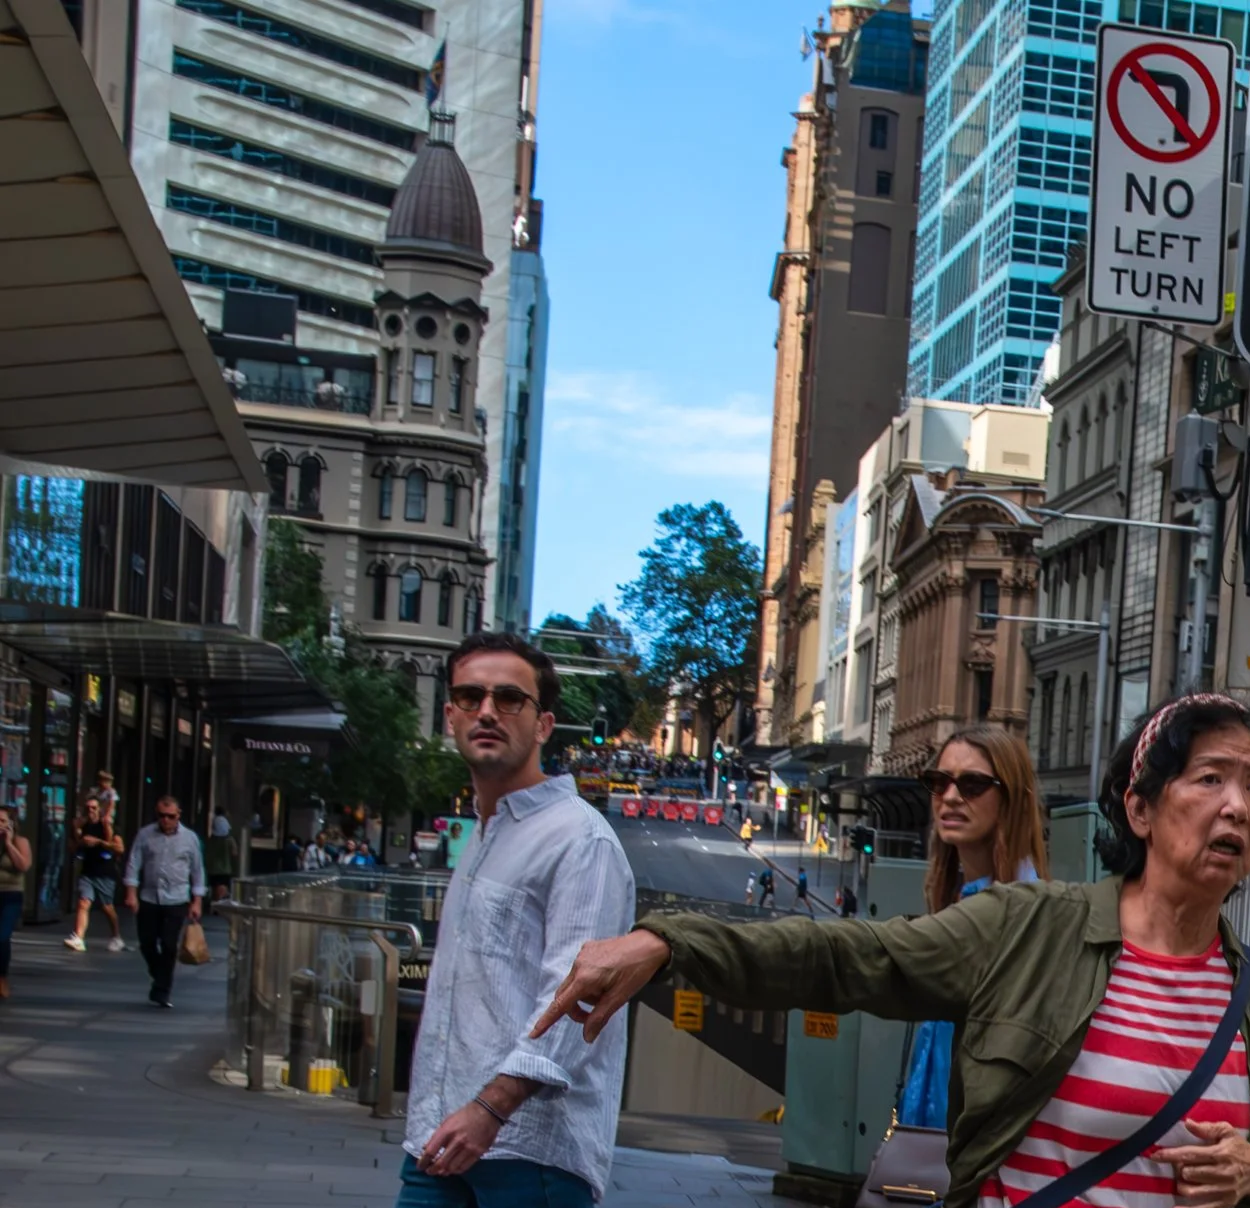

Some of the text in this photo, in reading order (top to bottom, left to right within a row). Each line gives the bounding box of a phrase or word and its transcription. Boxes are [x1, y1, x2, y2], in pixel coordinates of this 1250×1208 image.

[1125, 172, 1195, 220] NO
[1114, 225, 1202, 264] LEFT
[1109, 266, 1204, 306] TURN
